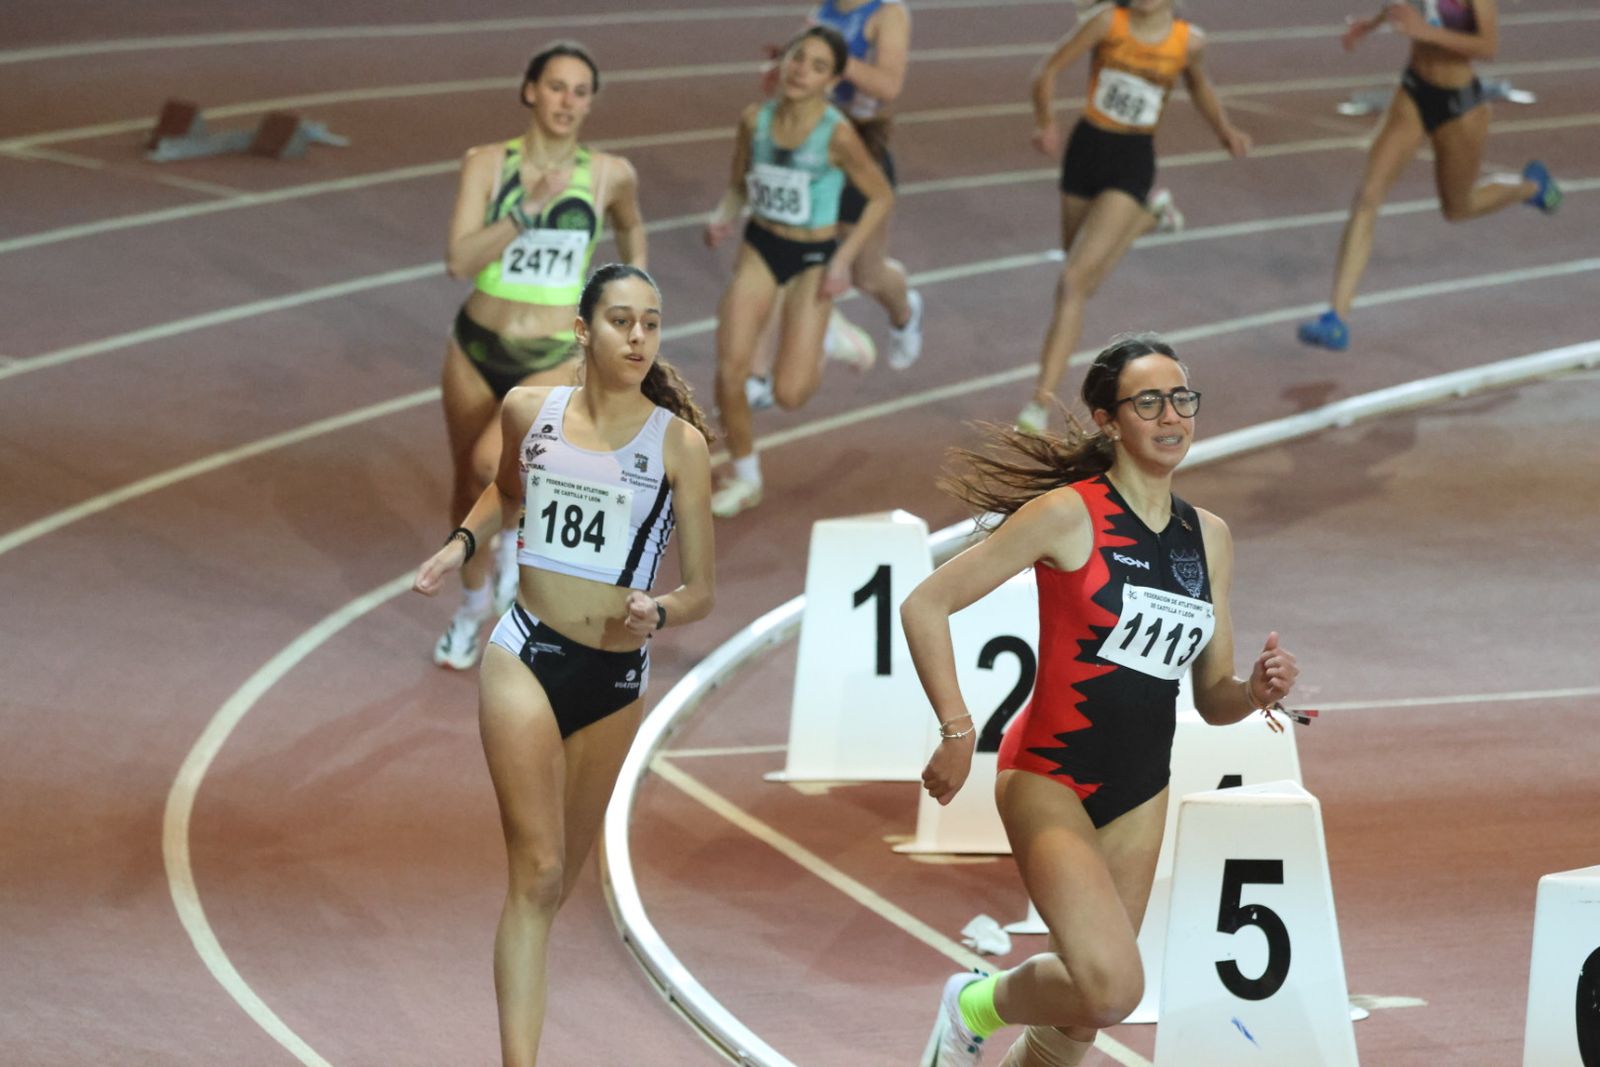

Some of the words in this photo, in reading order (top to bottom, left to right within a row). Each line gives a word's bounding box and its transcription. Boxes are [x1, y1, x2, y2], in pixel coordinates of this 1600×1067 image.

[509, 247, 574, 277] 2471
[545, 478, 576, 489] FEDERACIÓN
[583, 486, 609, 497] ATLETISMO
[560, 490, 583, 500] CASTILLA
[588, 495, 601, 503] LEÓN
[629, 478, 658, 490] Salamanca
[541, 500, 606, 553] 184
[1143, 591, 1171, 603] FEDERACIÓN
[1171, 598, 1178, 606] DE
[1178, 599, 1203, 611] ATLETISMO
[1157, 603, 1177, 614] CASTILLA
[1182, 609, 1195, 618] LEÓN
[853, 564, 892, 676] 1
[1119, 611, 1203, 667] 1113
[976, 635, 1037, 753] 2
[1215, 859, 1291, 1001] 5
